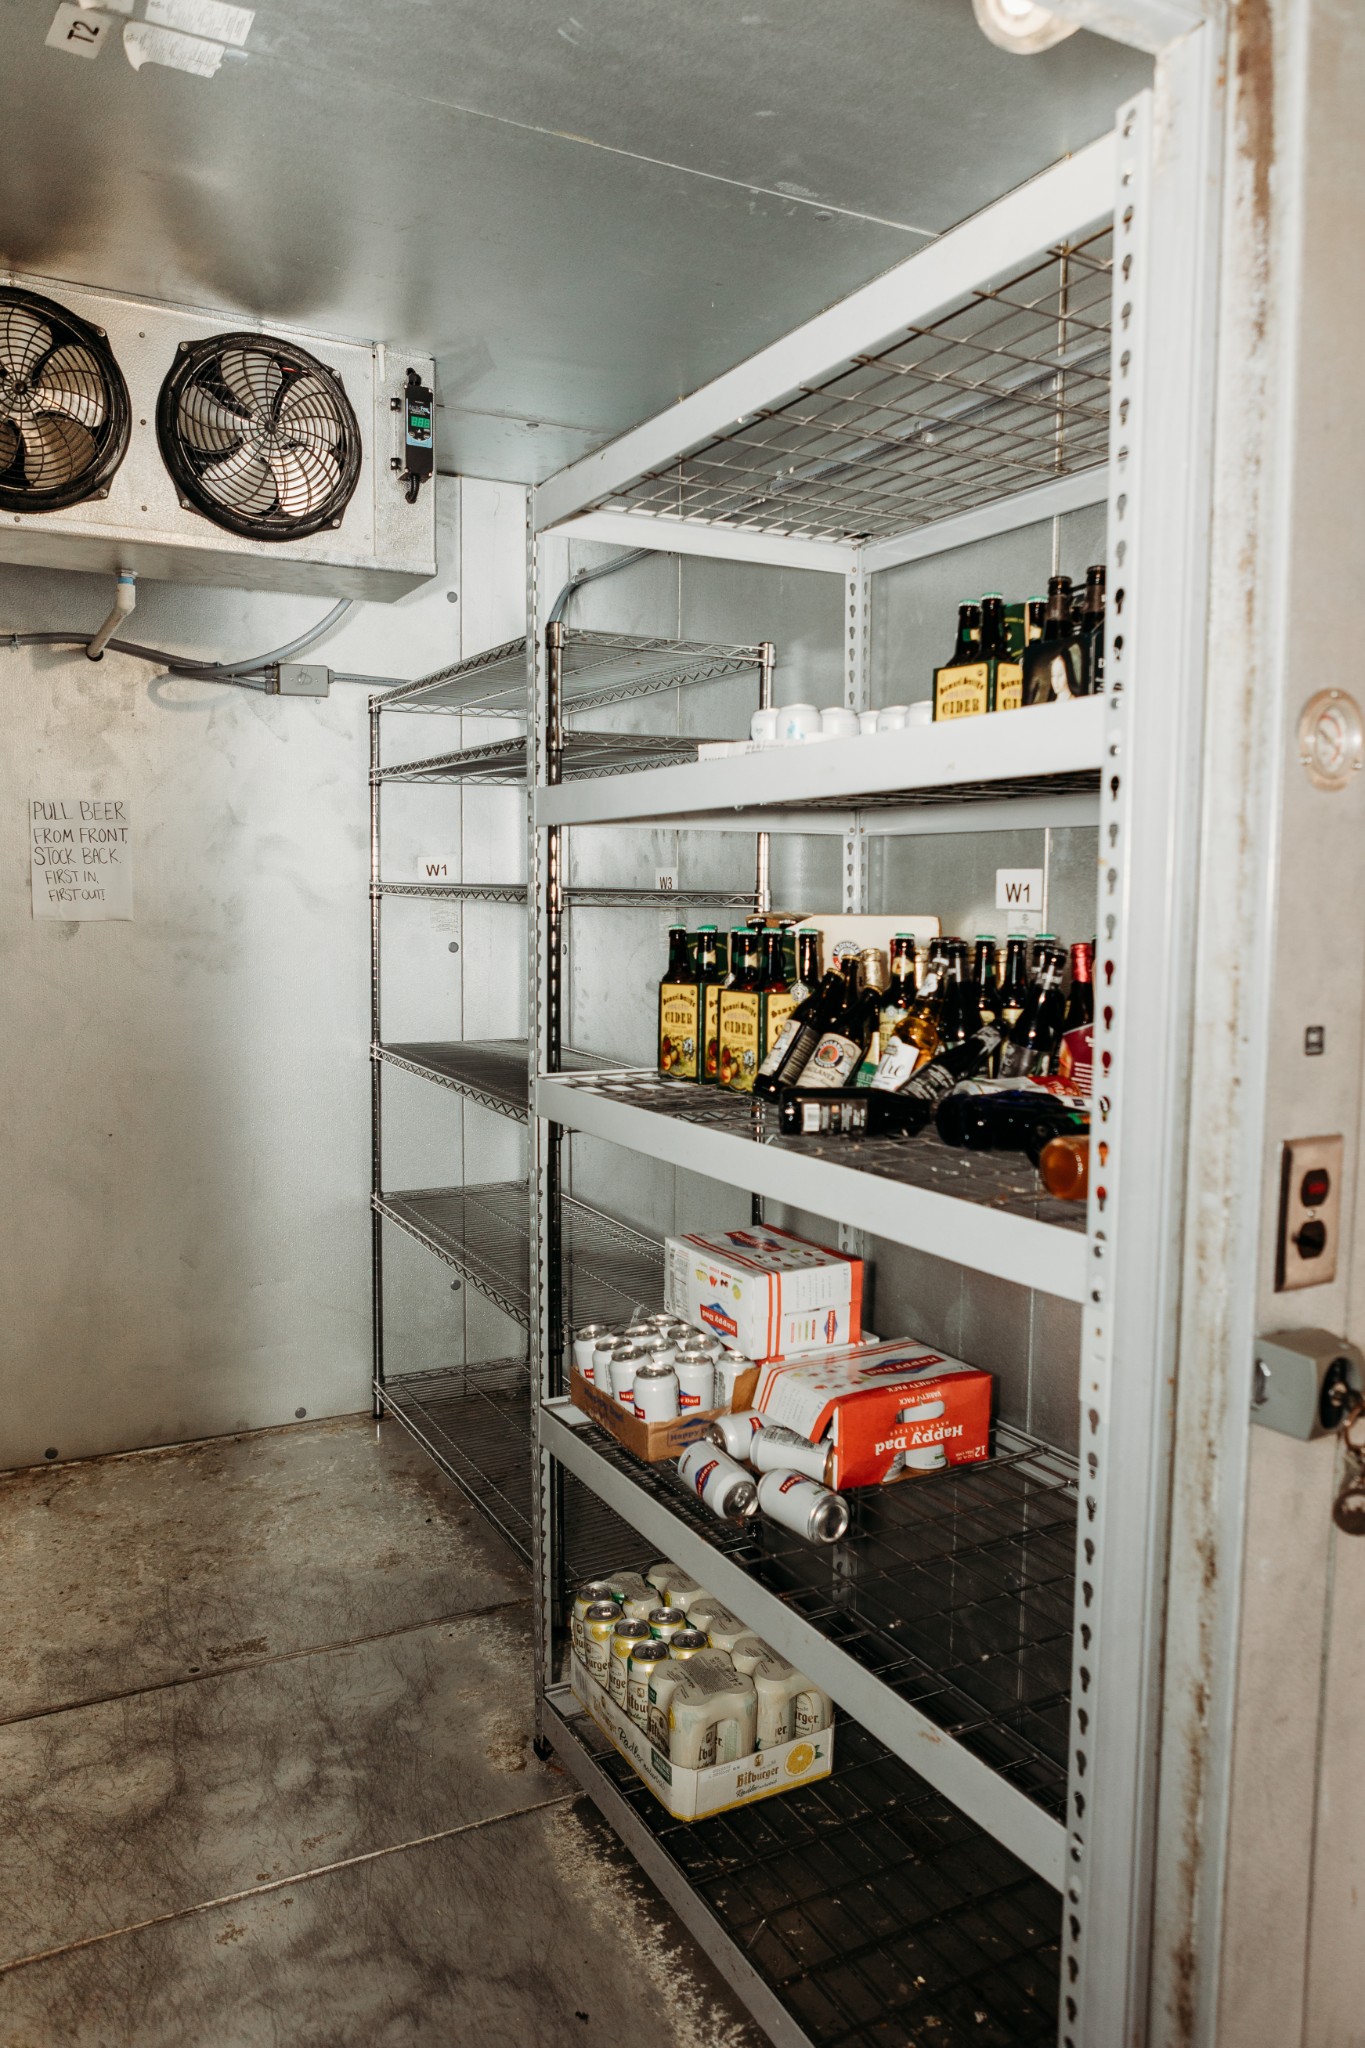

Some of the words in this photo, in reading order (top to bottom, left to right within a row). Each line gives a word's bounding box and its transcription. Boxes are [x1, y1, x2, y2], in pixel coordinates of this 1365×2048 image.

[67, 20, 100, 44] T2
[942, 698, 980, 715] CIDER
[33, 801, 73, 820] PULL
[79, 801, 126, 820] BEER
[33, 828, 74, 844] FROM
[34, 846, 76, 865] STOCK
[45, 869, 78, 885] FIRST
[426, 864, 448, 877] W1
[659, 876, 673, 890] W3
[48, 888, 81, 902] FIRST
[1005, 883, 1030, 903] W1
[665, 1012, 693, 1025] CIDER
[724, 1021, 754, 1036] CIDER
[714, 1315, 736, 1334] Happy
[867, 1367, 894, 1376] Dad
[895, 1357, 939, 1370] Happy
[886, 1384, 908, 1393] PACK
[898, 1397, 915, 1406] PACK
[911, 1425, 963, 1445] Happy
[875, 1436, 907, 1456] Dad
[974, 1445, 986, 1458] 12
[736, 1766, 779, 1788] Bitburger
